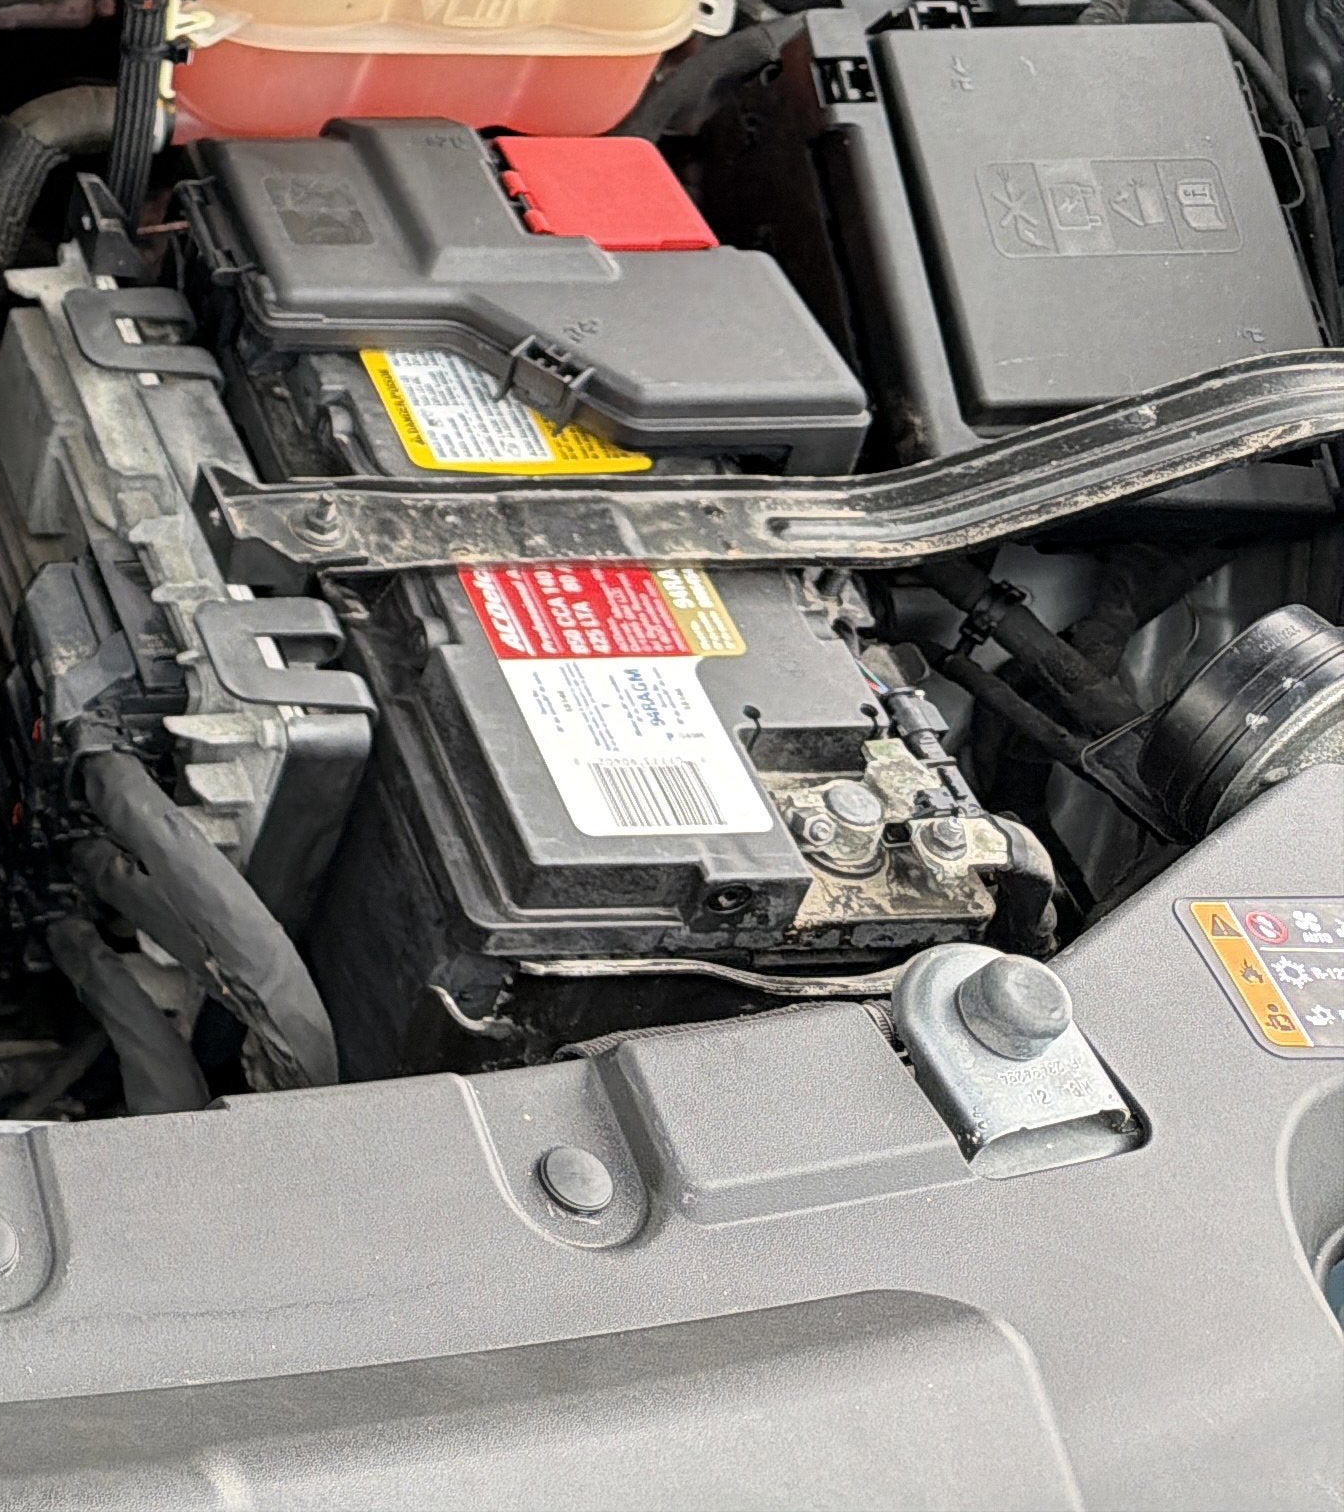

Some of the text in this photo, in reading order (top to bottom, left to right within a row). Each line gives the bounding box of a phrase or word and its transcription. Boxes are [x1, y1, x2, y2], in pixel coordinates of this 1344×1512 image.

[657, 568, 696, 609] 94RA
[473, 569, 528, 653] ACDelc
[1311, 966, 1344, 980] R-12
